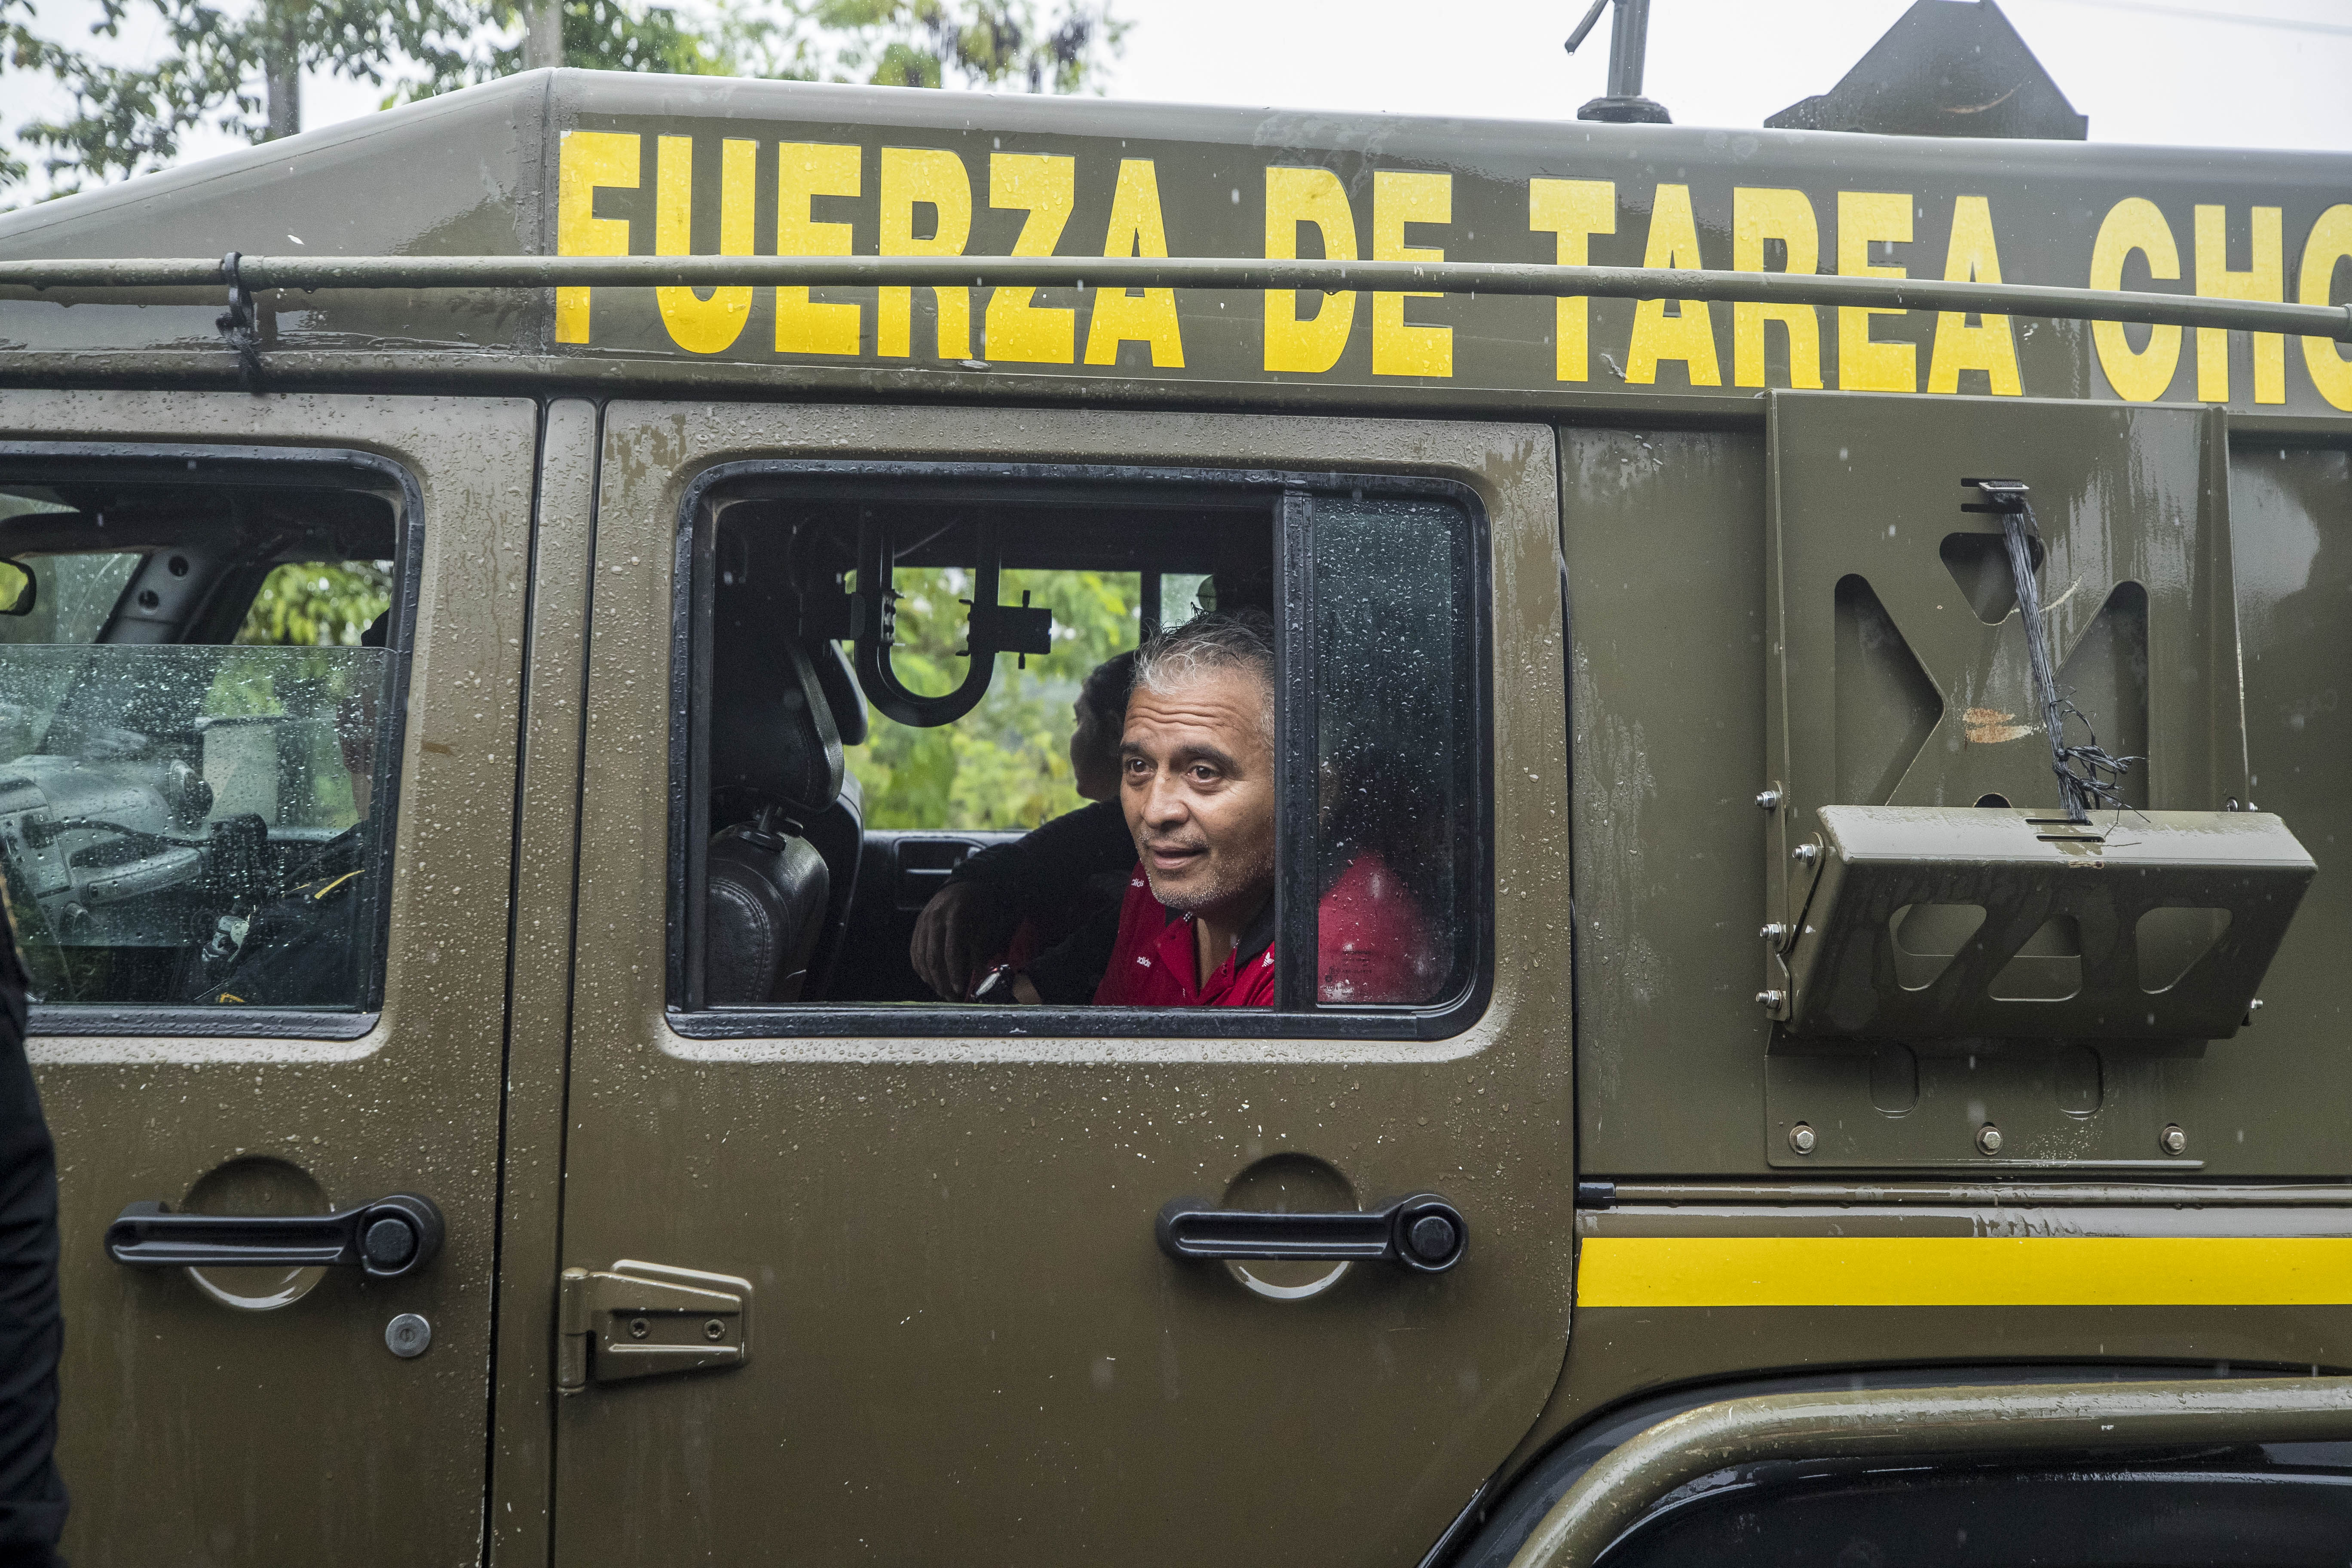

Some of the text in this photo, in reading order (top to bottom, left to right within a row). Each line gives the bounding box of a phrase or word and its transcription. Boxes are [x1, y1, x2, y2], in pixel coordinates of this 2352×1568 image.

[555, 131, 1185, 368] FUERZA
[1264, 167, 1453, 377] DE
[1529, 178, 2023, 396] TAREA
